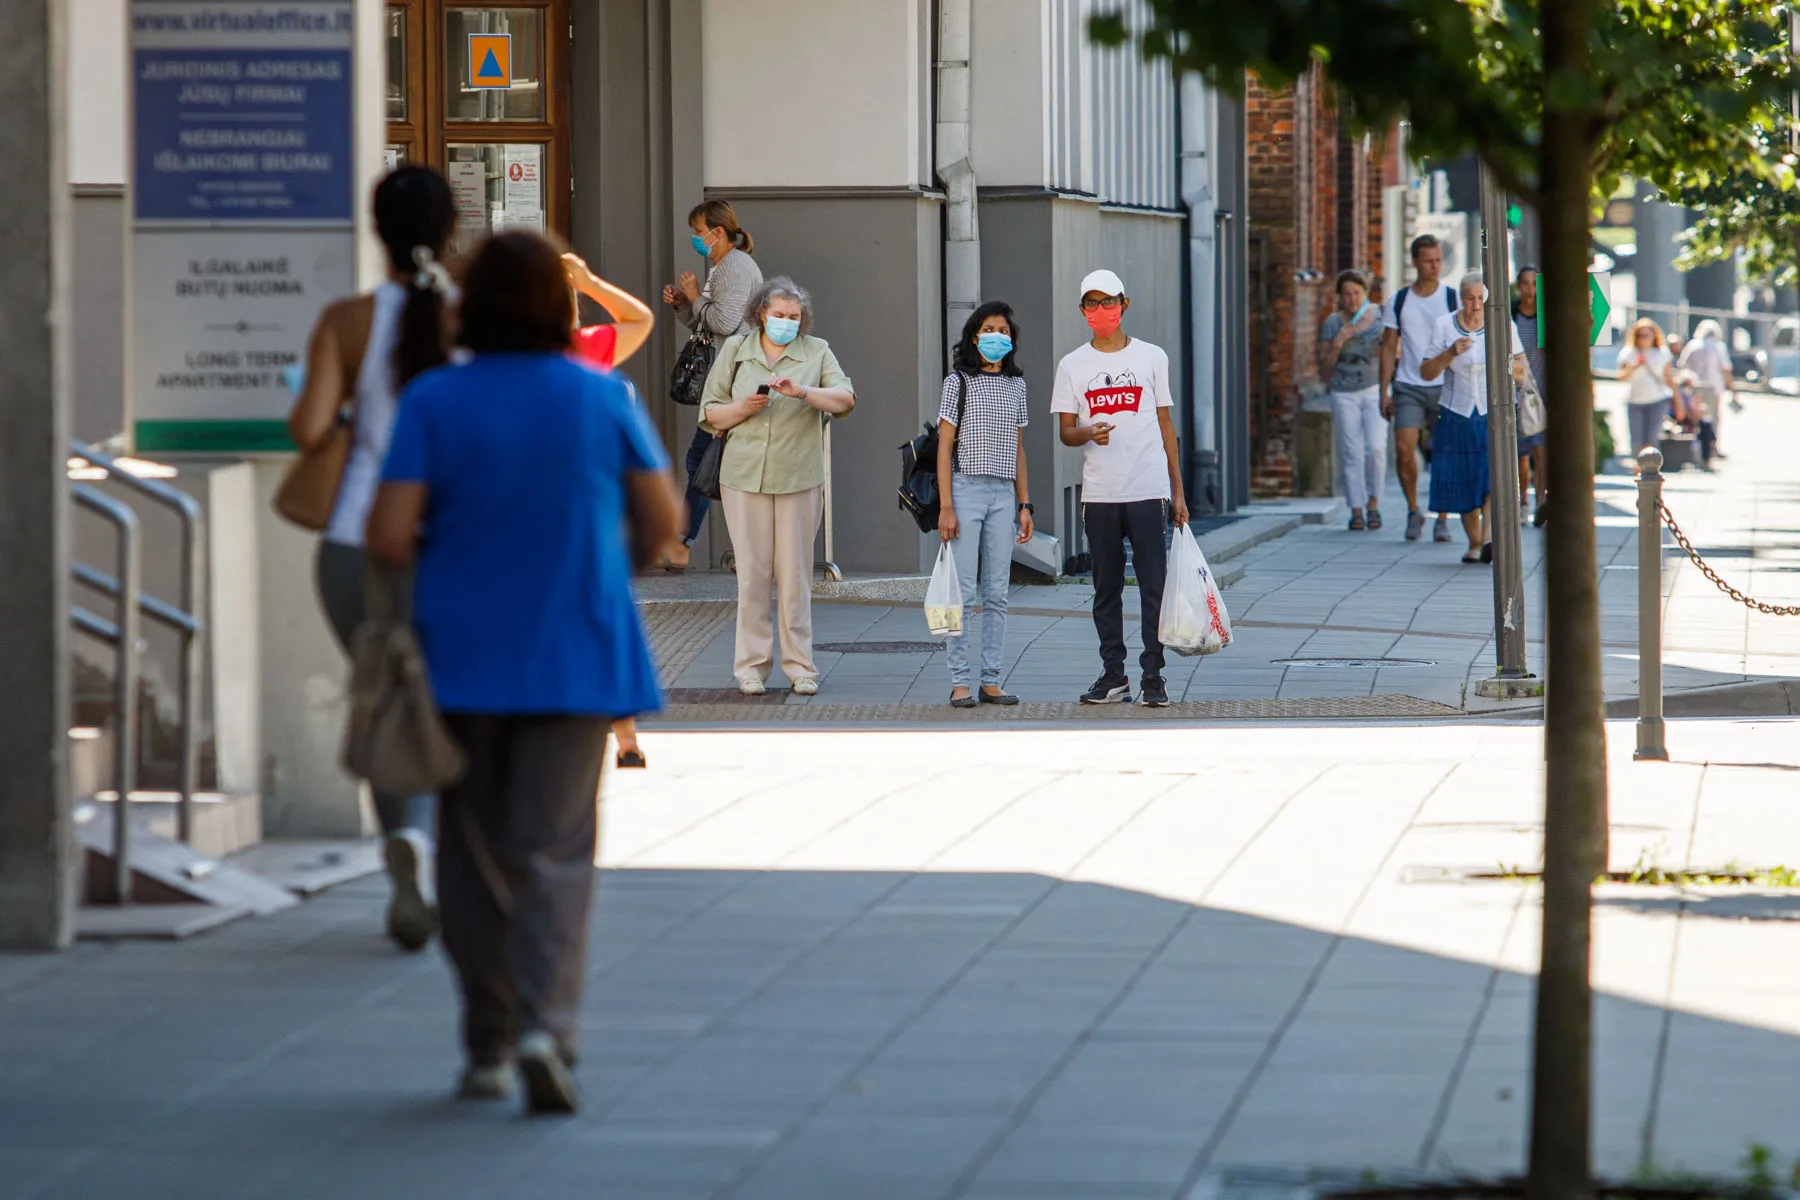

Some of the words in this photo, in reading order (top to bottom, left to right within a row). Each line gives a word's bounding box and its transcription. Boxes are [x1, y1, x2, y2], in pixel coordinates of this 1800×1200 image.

[134, 10, 351, 31] www.virtualoffice.lt
[142, 61, 240, 79] JURIDINIS
[246, 61, 342, 79] ADRESAS
[233, 279, 304, 296] NUOMA
[185, 351, 240, 368] LONG
[246, 351, 298, 367] TERM
[156, 372, 272, 389] APARTMENT
